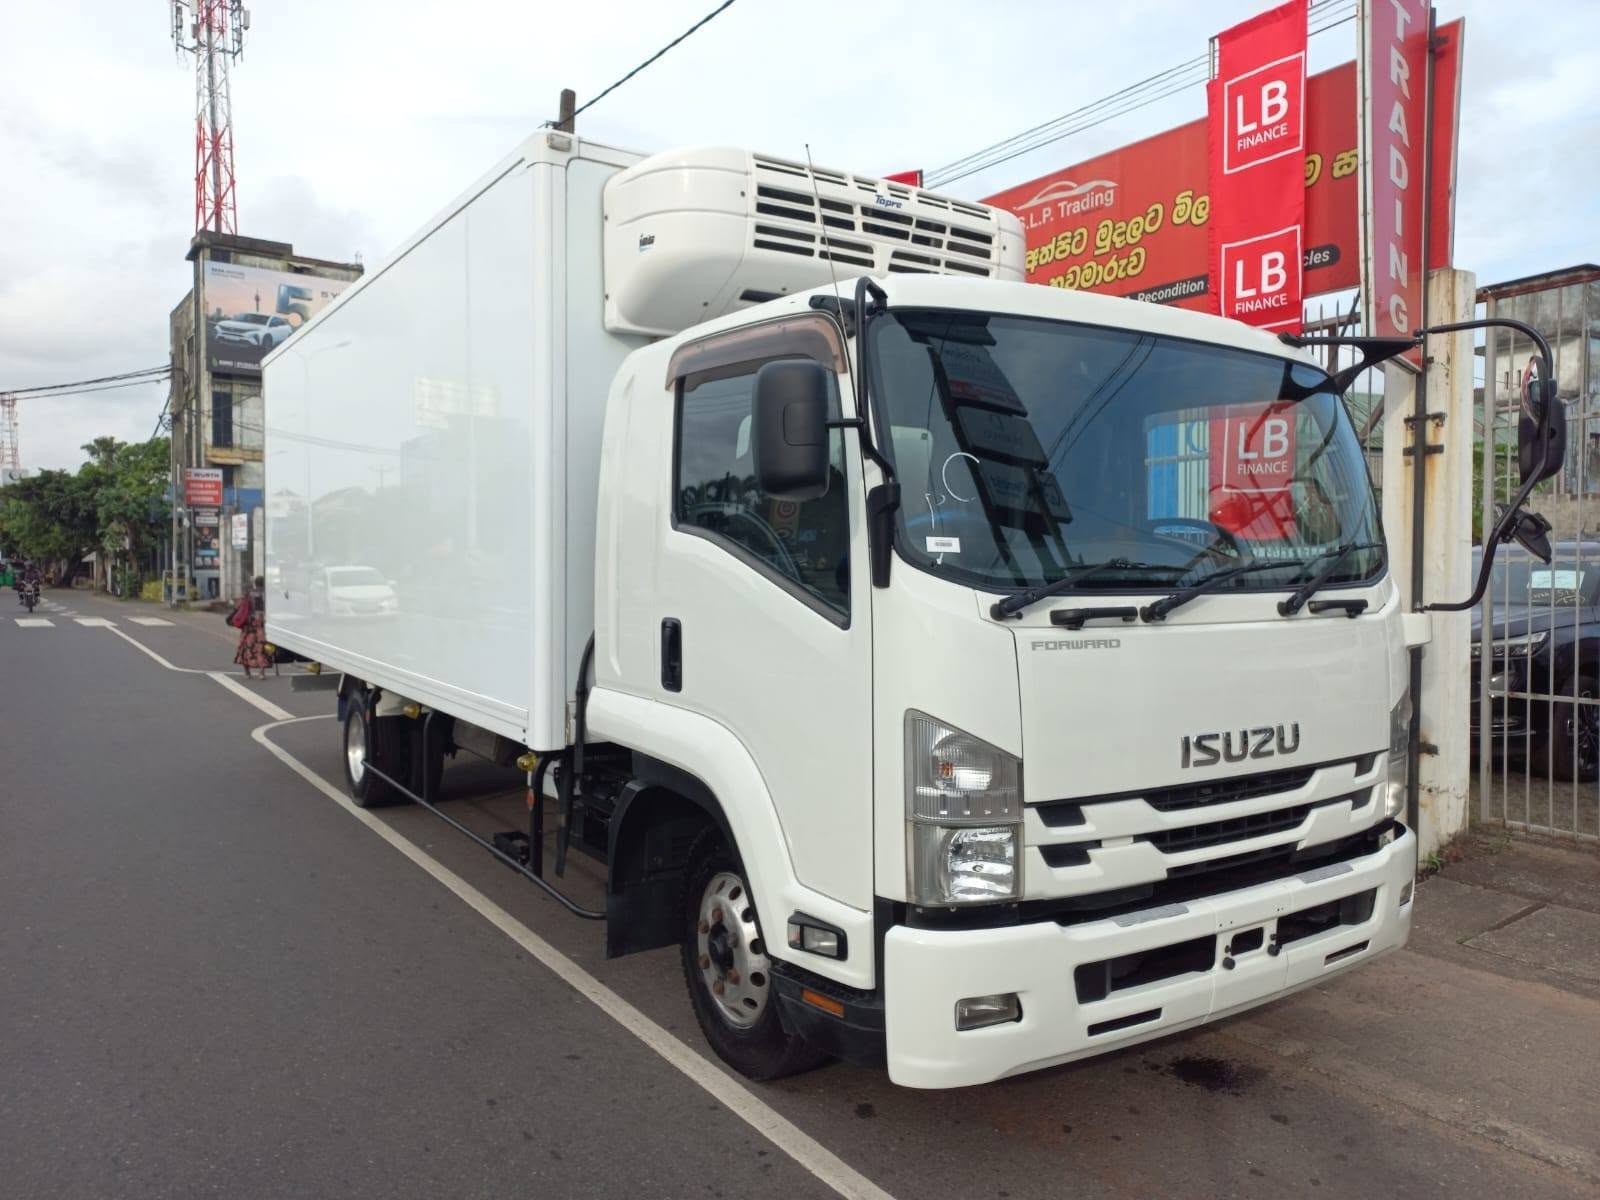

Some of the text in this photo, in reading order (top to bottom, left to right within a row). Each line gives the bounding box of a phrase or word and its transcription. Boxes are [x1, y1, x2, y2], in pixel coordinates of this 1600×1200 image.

[1236, 79, 1289, 136] LB
[1237, 123, 1288, 153] FINANCE
[1389, 0, 1412, 333] TRADING
[875, 194, 902, 209] Topre
[1058, 188, 1114, 218] Trading
[1093, 203, 1164, 256] මුදලට
[1235, 251, 1287, 300] LB
[1138, 279, 1204, 303] Recondition
[1235, 294, 1288, 314] FINANCE
[1238, 419, 1289, 460] LB
[1237, 461, 1289, 475] FINANCE
[1031, 638, 1121, 651] FORWARD
[1180, 722, 1300, 770] ISUZU
